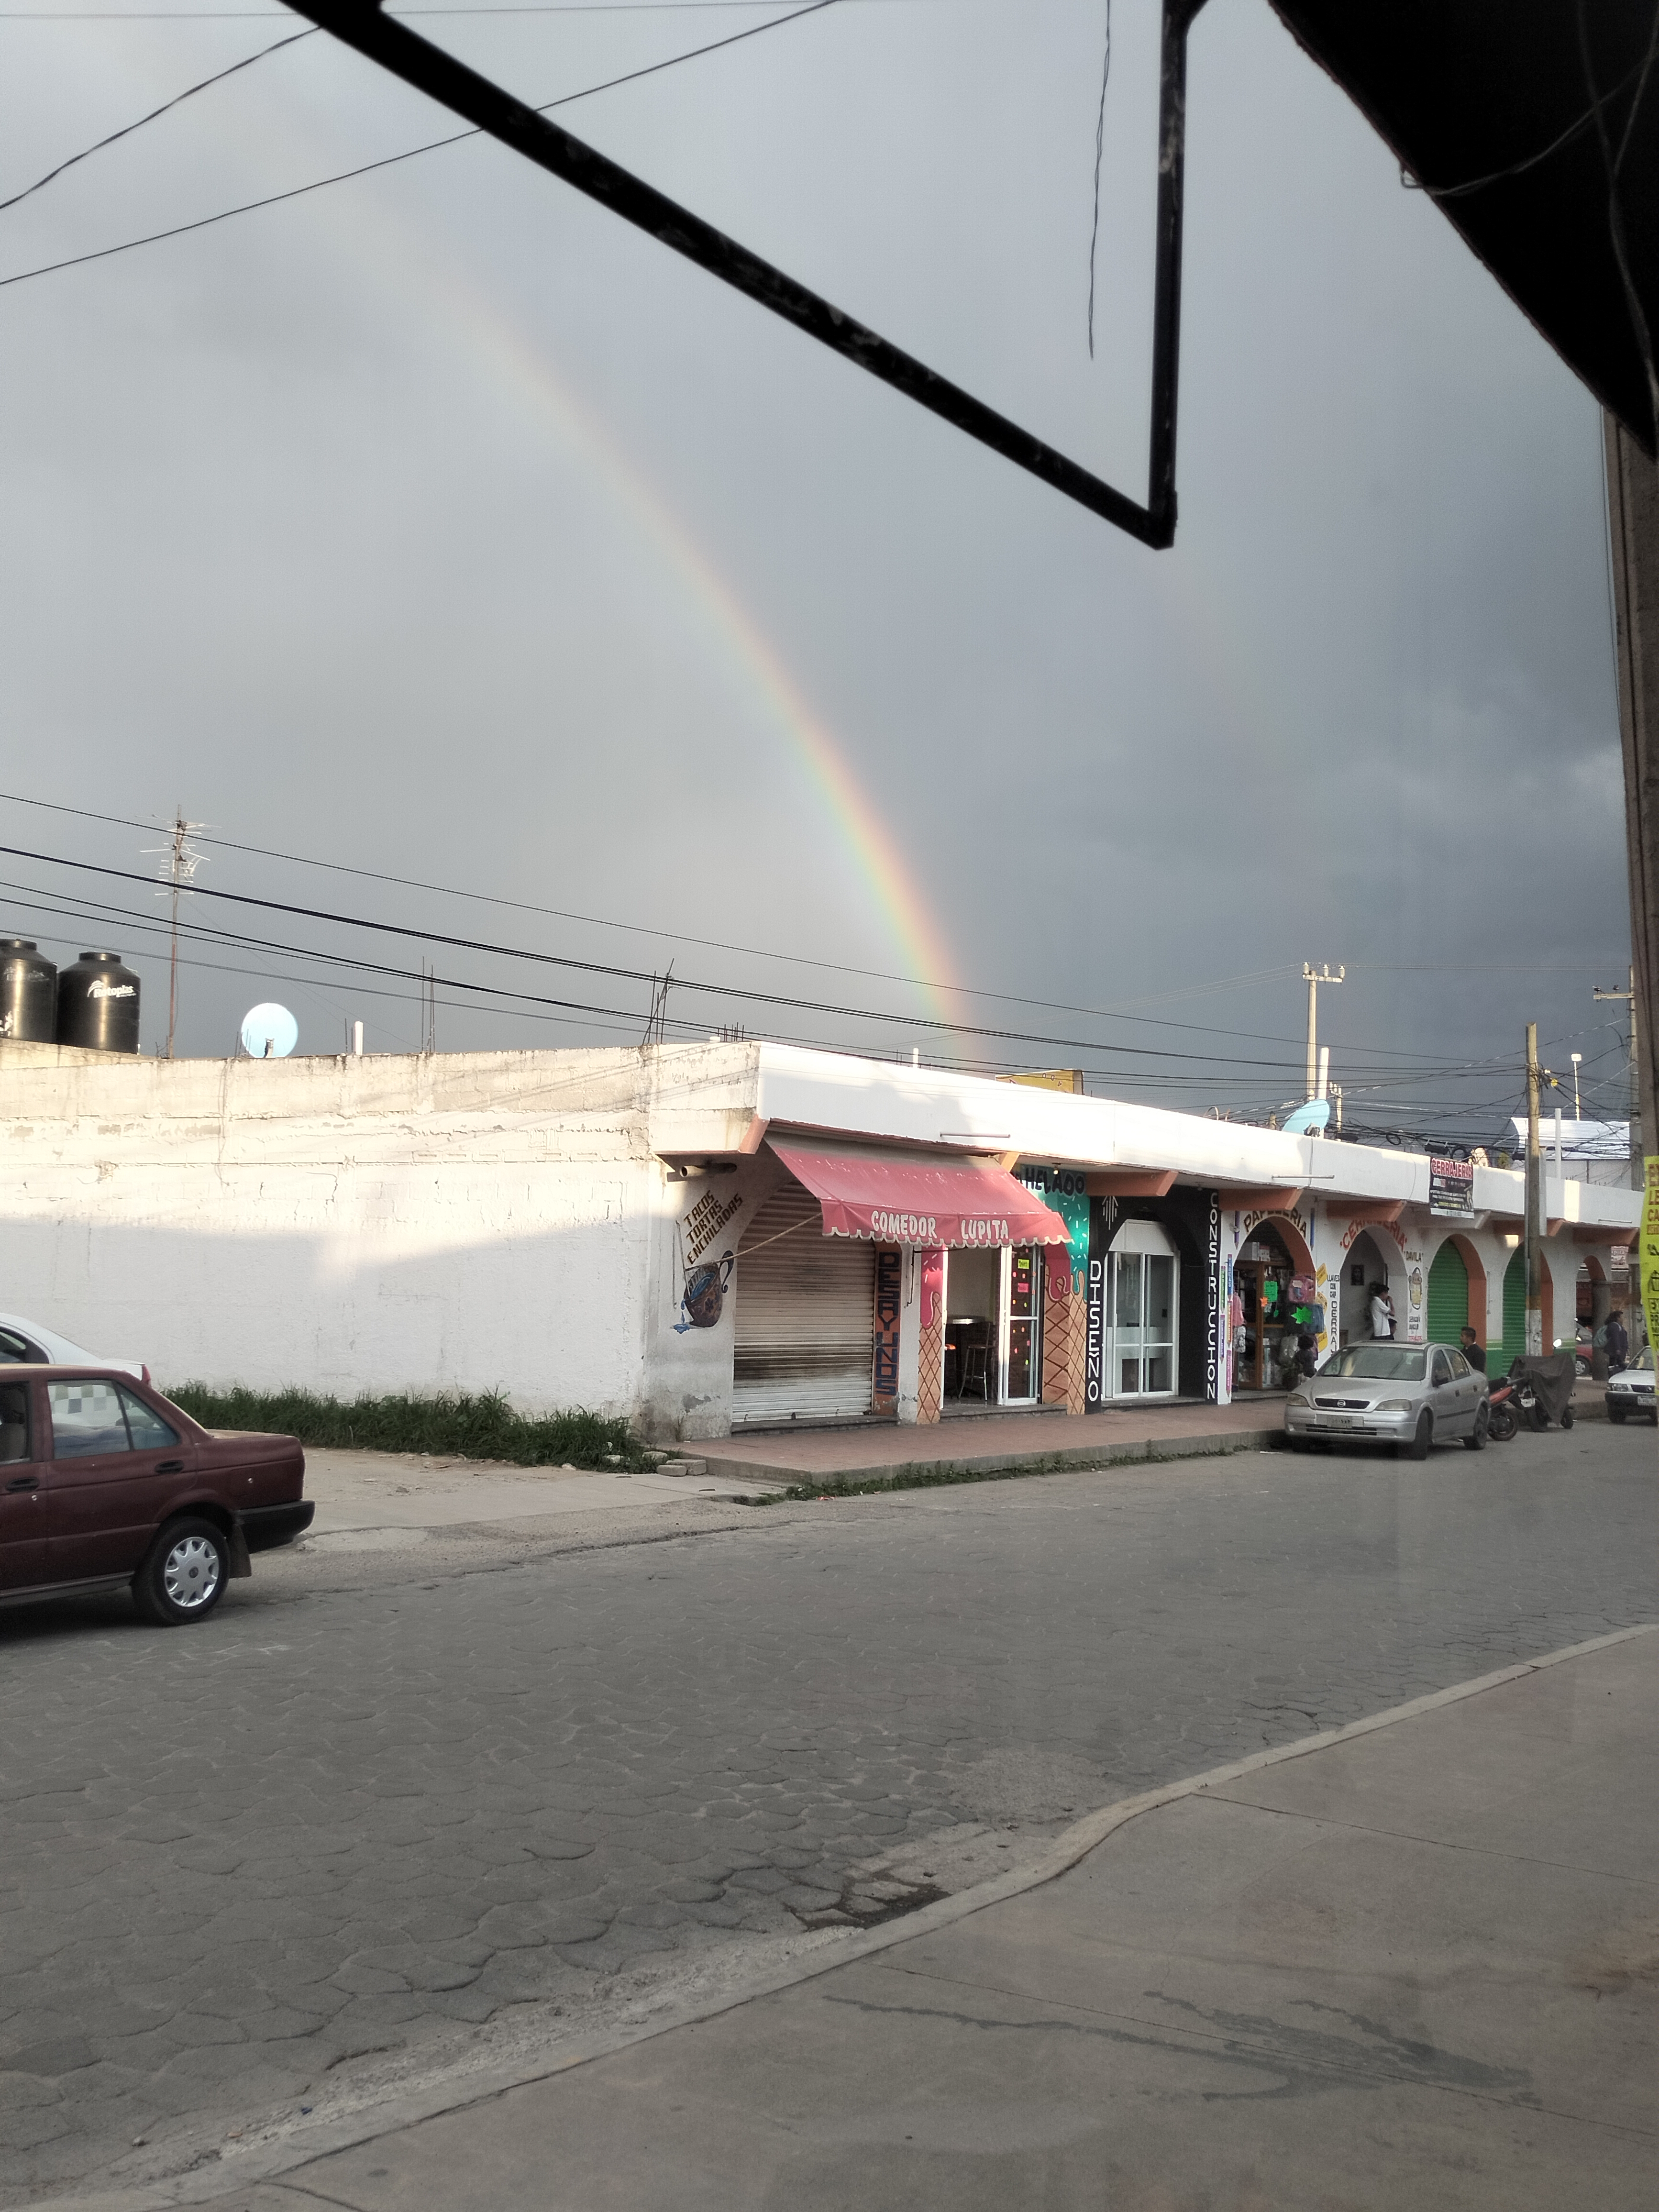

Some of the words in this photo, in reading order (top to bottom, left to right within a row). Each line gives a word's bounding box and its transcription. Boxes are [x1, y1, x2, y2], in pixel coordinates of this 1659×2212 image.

[93, 984, 135, 998] Rotoplas
[1025, 1167, 1085, 1196] HELADO
[1431, 1158, 1473, 1181] CERRAJERIA
[683, 1190, 715, 1228] TACOS
[686, 1200, 723, 1244] TORTAS
[871, 1210, 938, 1239] COMEDOR
[961, 1219, 1009, 1240] LUPITA
[1243, 1207, 1307, 1239] PARIA
[687, 1193, 743, 1265] ENCHILADAS
[1206, 1193, 1219, 1400] CONSTRUCCION
[874, 1251, 900, 1396] DESAYUNOS
[1088, 1260, 1101, 1402] DISEÑO
